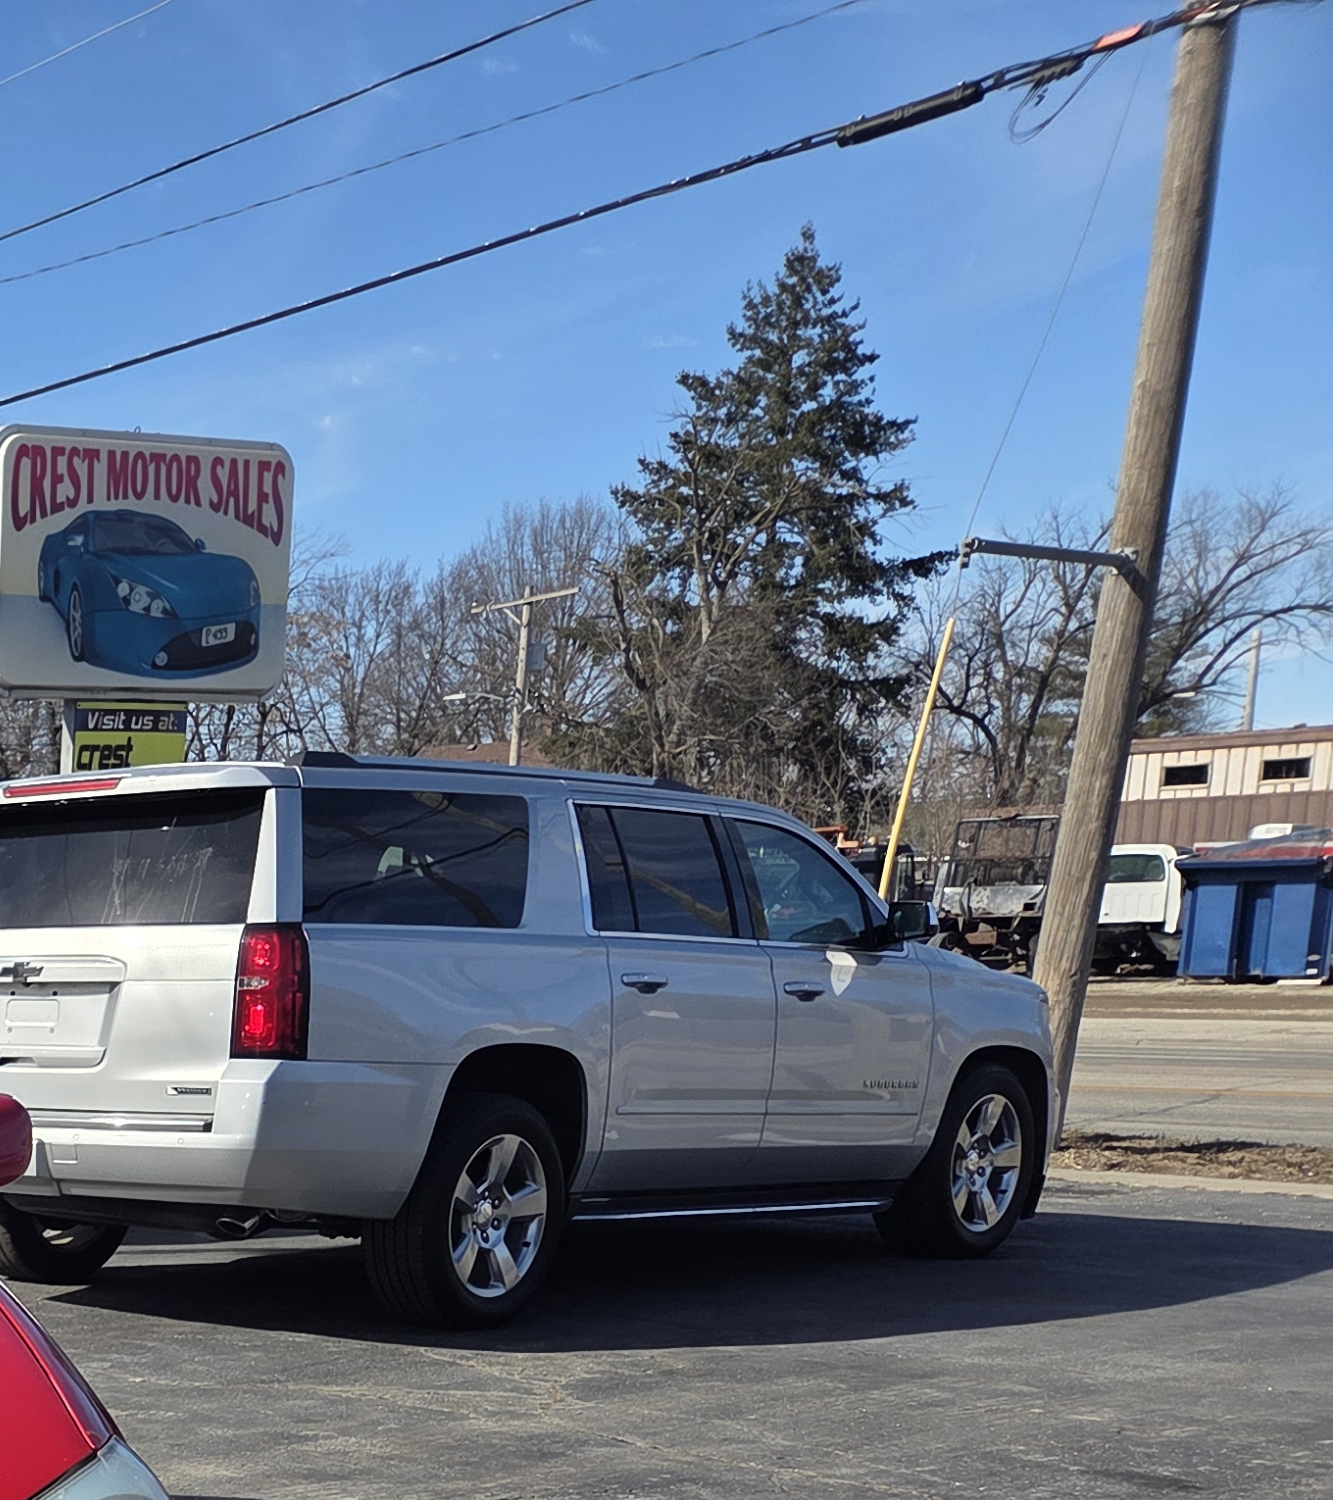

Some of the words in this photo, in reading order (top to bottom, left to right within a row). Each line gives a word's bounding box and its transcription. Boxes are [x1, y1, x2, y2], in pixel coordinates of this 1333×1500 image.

[11, 443, 101, 532] CREST
[106, 449, 202, 508] MOTOR
[209, 455, 286, 547] SALES
[87, 711, 126, 730] Visit
[130, 714, 154, 730] us
[158, 712, 178, 731] at:
[76, 736, 133, 771] crest
